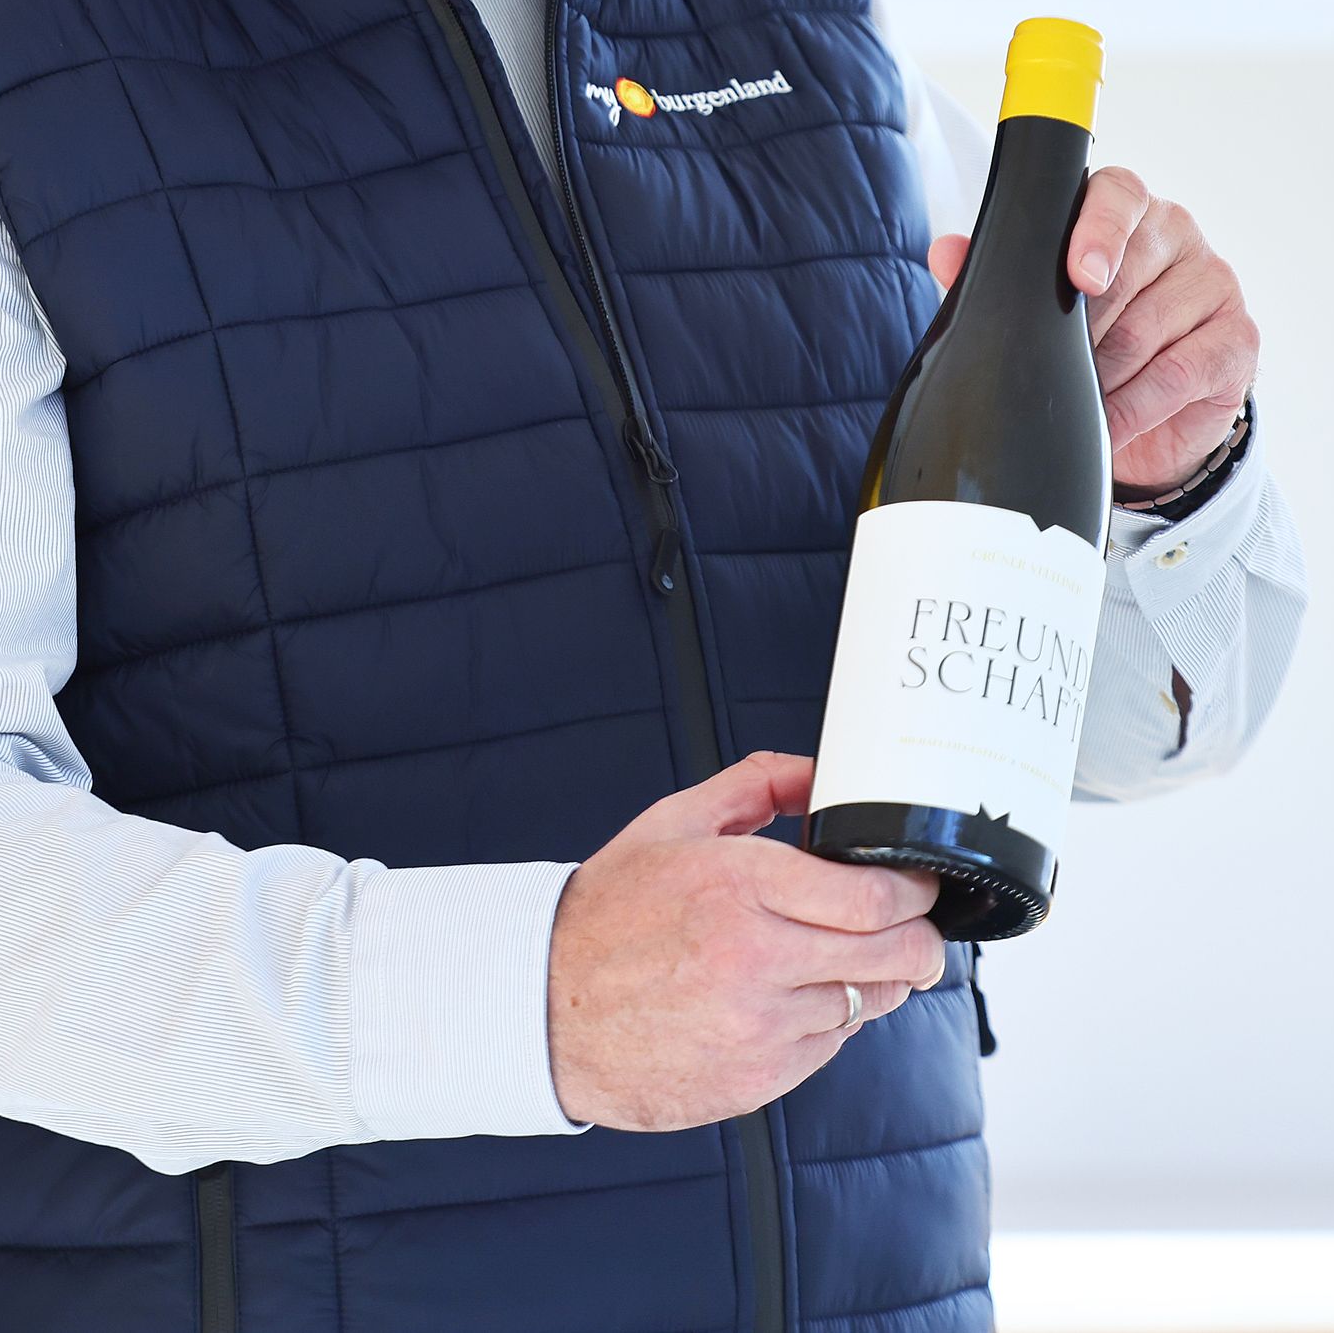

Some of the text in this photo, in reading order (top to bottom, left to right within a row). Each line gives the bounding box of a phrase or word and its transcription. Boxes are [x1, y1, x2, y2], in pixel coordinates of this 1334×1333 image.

[585, 70, 793, 127] my burgenland
[909, 598, 1088, 692] FREUND
[901, 645, 1083, 743] SCHAFT
